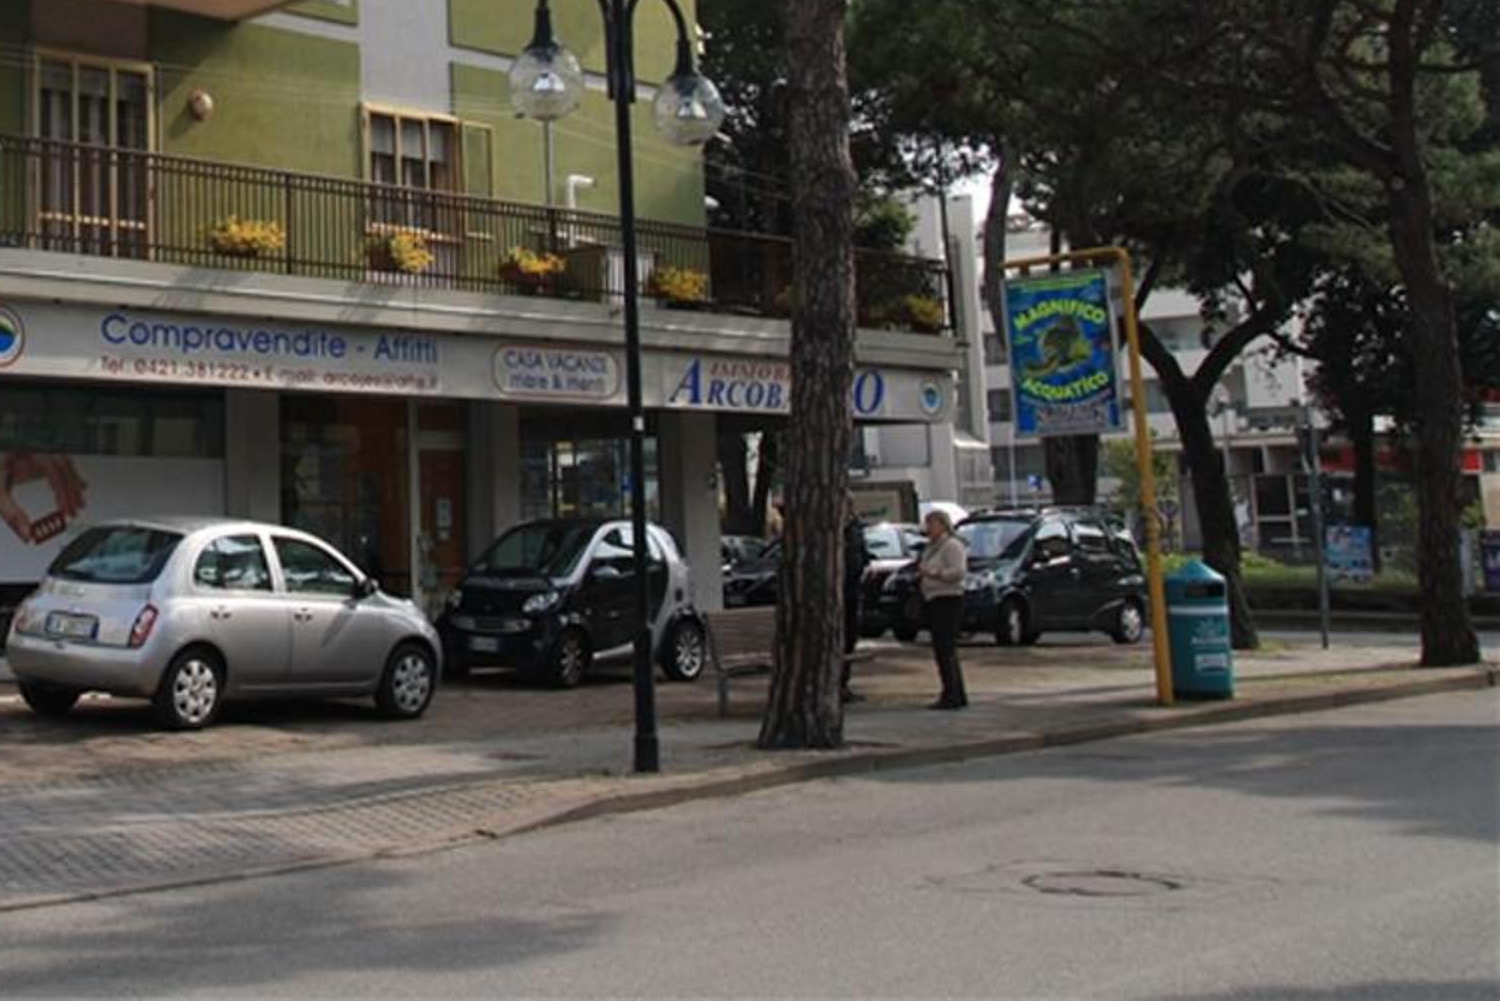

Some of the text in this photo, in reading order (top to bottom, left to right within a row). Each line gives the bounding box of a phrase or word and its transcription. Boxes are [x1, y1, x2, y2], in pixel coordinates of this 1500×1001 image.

[1013, 299, 1107, 330] MAGNIFICO
[100, 313, 347, 359] Compravendite
[374, 336, 439, 364] Affitti
[1023, 371, 1108, 400] ACQUATICO
